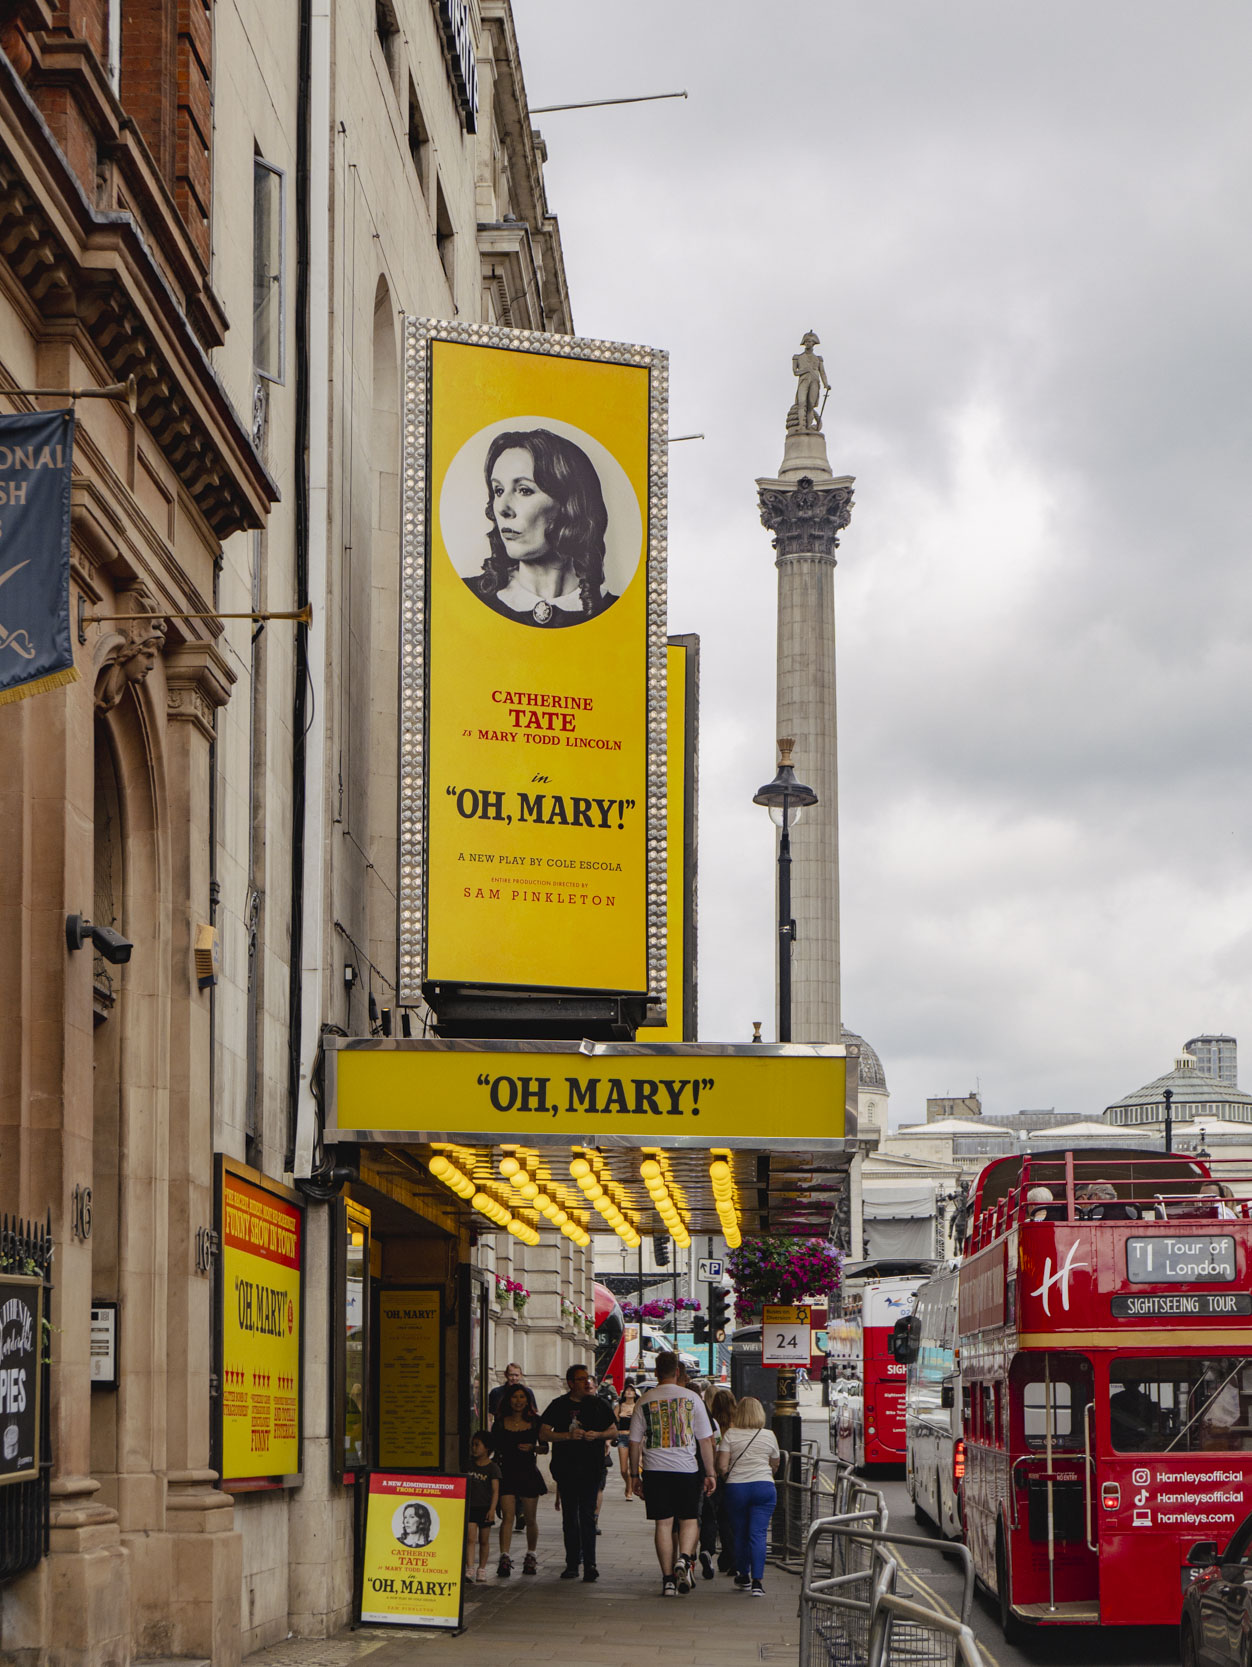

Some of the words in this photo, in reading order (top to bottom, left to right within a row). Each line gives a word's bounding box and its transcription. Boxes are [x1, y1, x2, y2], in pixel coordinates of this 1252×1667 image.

[491, 690, 593, 711] CATHERINE
[509, 709, 576, 732] TATE
[478, 729, 518, 743] MARY
[523, 733, 561, 746] TODD
[566, 736, 623, 751] LINCOLN
[531, 772, 553, 784] in
[446, 785, 513, 826] “OH,
[516, 792, 636, 830] MARY!”
[457, 852, 466, 862] A
[469, 853, 496, 864] NEW
[499, 855, 526, 866] PLAY
[529, 858, 543, 867] BY
[547, 858, 577, 870] COLE
[579, 861, 623, 872] ESCOLA
[513, 878, 551, 887] PRODUCTION
[463, 887, 501, 900] SAM
[512, 890, 616, 906] PINKLETON
[477, 1073, 559, 1118] “OH,
[564, 1077, 715, 1116] MARY!”
[73, 1183, 92, 1240] 16
[225, 1205, 250, 1241] FUNNY
[250, 1216, 270, 1248] SHOW
[269, 1224, 278, 1252] IN
[1164, 1240, 1203, 1255] Tour
[1209, 1239, 1228, 1254] of
[711, 1263, 719, 1274] P
[1166, 1260, 1230, 1275] London
[1030, 1239, 1088, 1317] H
[1127, 1298, 1199, 1314] SIGHTSEEING
[1207, 1296, 1237, 1312] TOUR
[776, 1333, 798, 1349] 24
[1157, 1470, 1243, 1485] Hamleysofficial
[402, 1482, 455, 1490] ADMINISTRATION
[1157, 1491, 1244, 1506] Hamleysofficial
[1158, 1512, 1235, 1526] hamleys.com
[391, 1549, 437, 1558] CATHERINE
[398, 1557, 429, 1567] TATE
